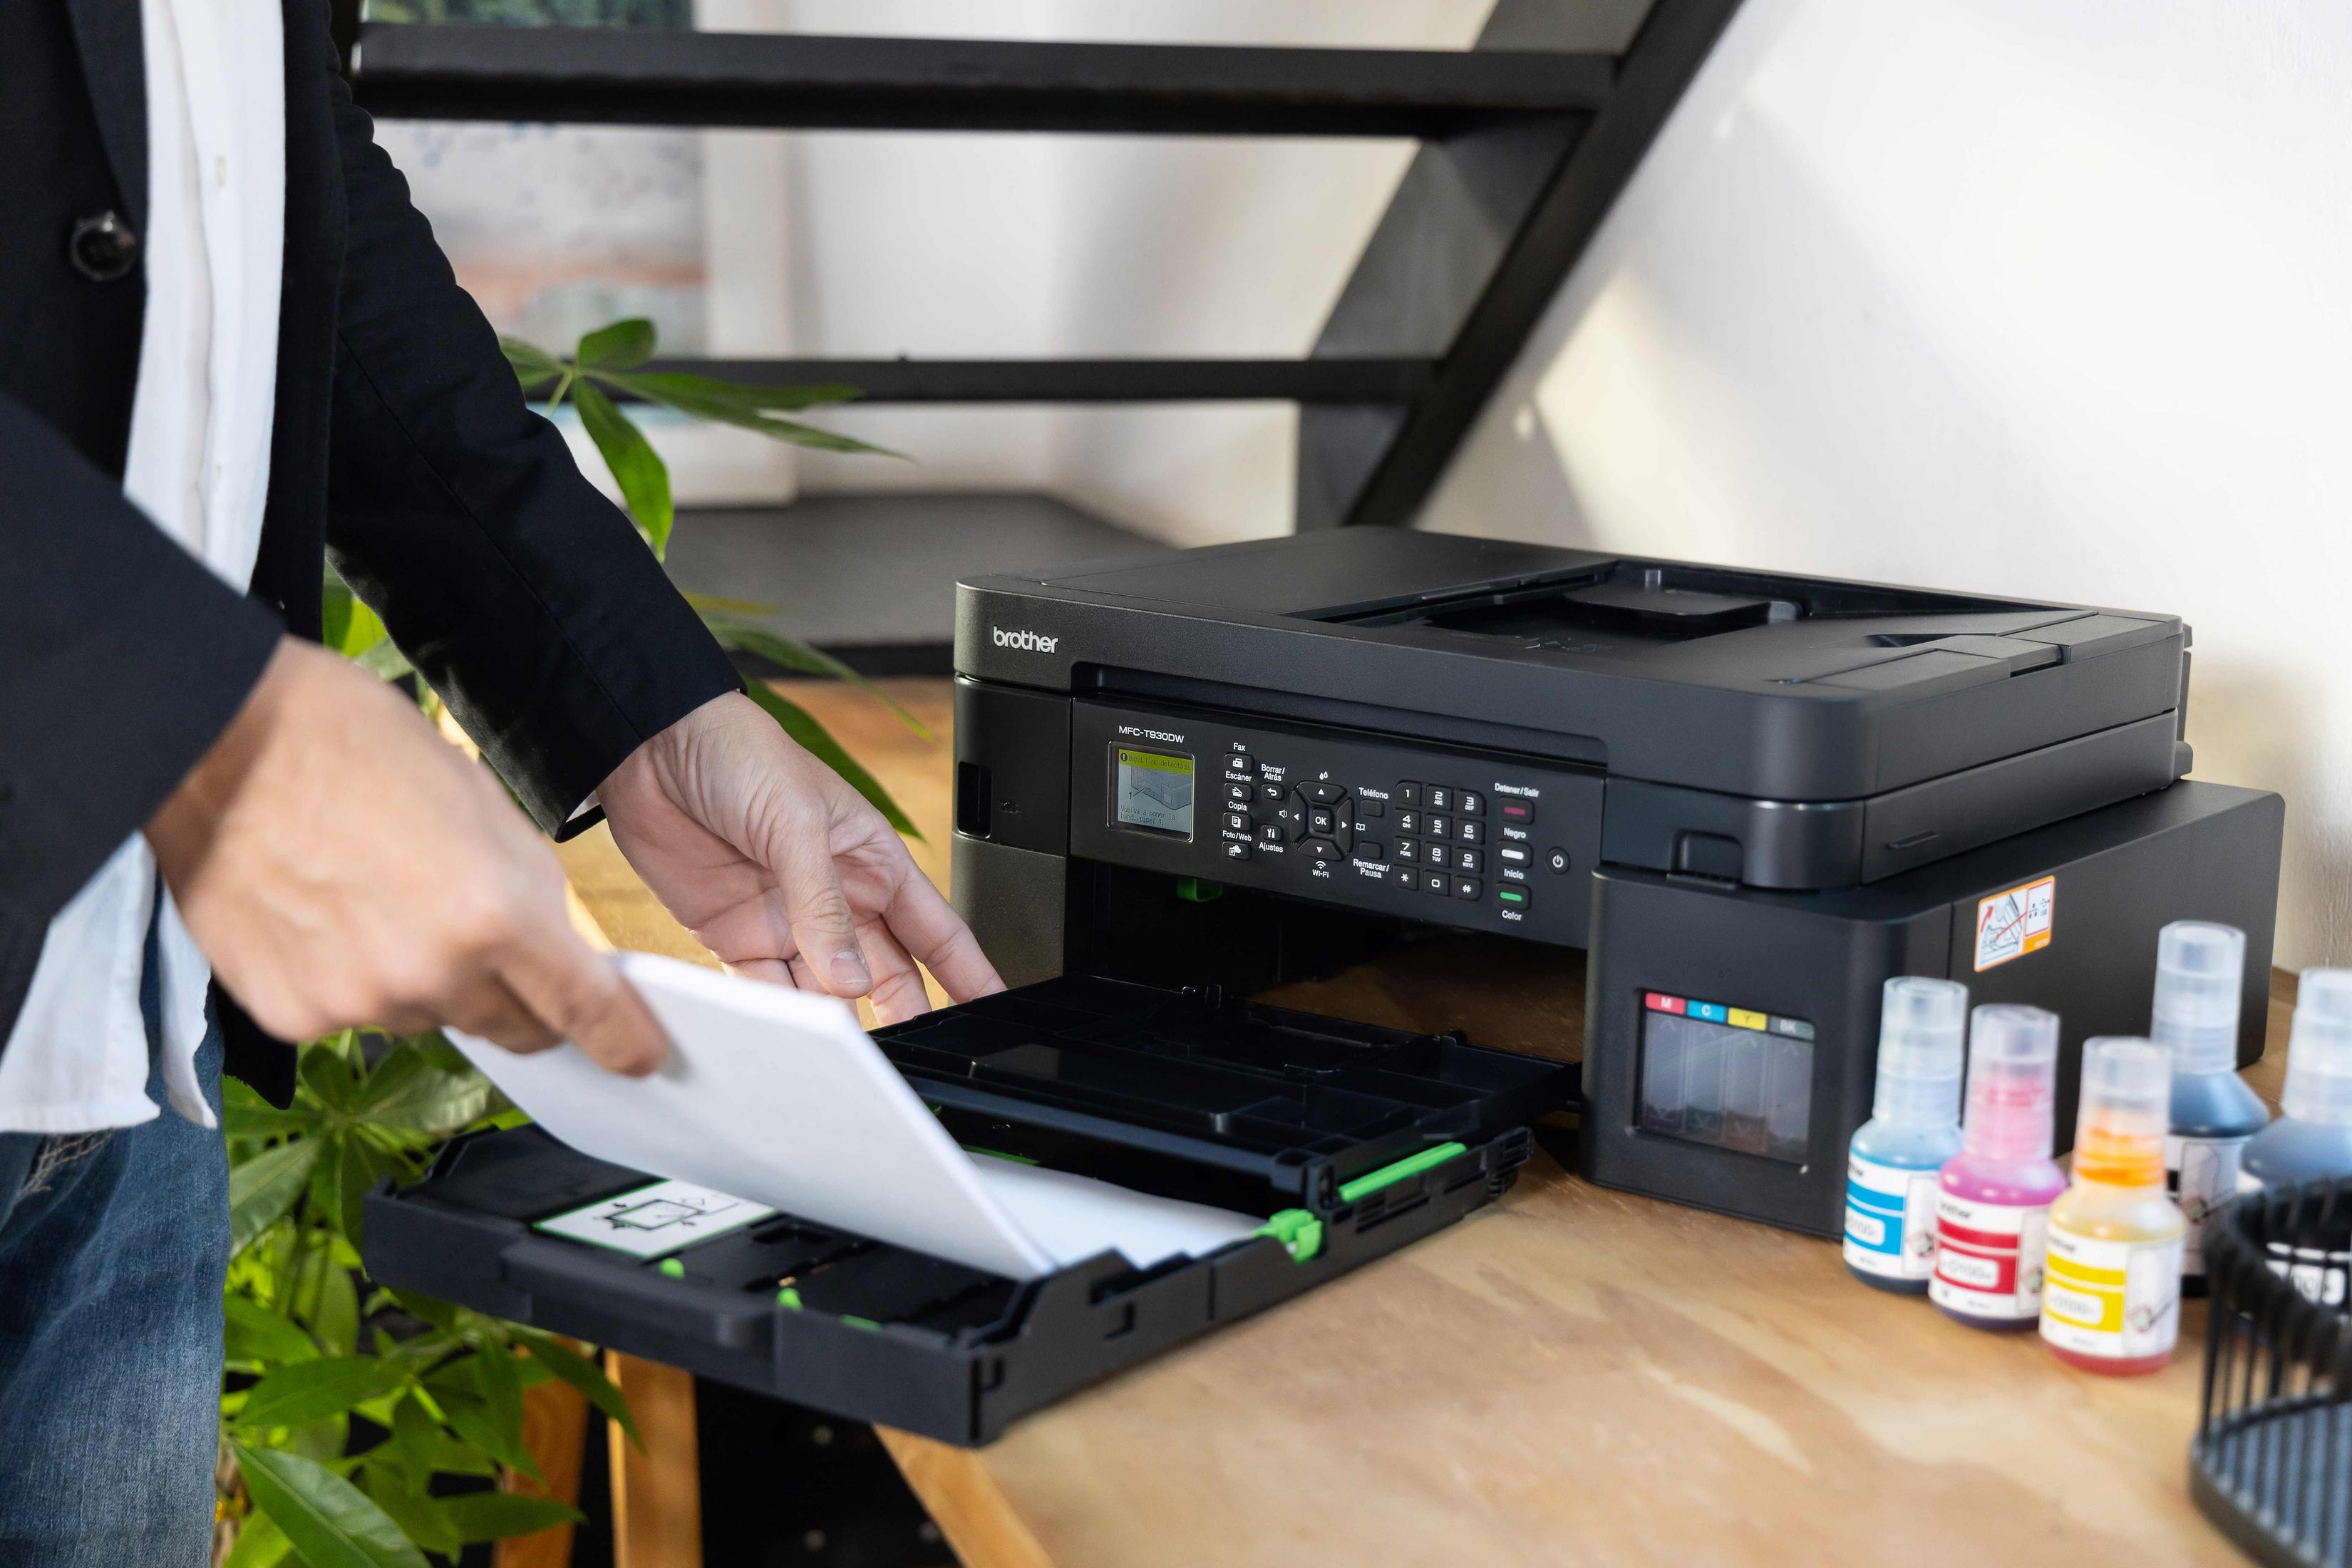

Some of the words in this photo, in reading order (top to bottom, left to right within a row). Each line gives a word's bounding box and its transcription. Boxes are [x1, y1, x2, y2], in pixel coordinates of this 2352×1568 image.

[993, 626, 1058, 654] brother
[1118, 725, 1185, 743] MFC-T930DW
[1233, 742, 1246, 751] Fax
[1161, 760, 1190, 770] detectada
[1261, 763, 1286, 775] Borrar/
[1225, 770, 1252, 782] Escáner
[1264, 772, 1282, 782] Atrás
[1358, 787, 1389, 800] Teléfono
[1405, 789, 1410, 798] 1
[1435, 791, 1443, 800] 2
[1494, 783, 1540, 798] Detener/Salir
[1466, 796, 1475, 805] 3
[1228, 801, 1247, 812] Copia
[1120, 805, 1140, 814] Vuelva
[1149, 811, 1166, 820] poner
[1140, 816, 1156, 826] papel
[1315, 816, 1327, 825] OK
[1402, 815, 1410, 823] 4
[1434, 820, 1442, 828] 5
[1465, 825, 1473, 834] 6
[1503, 827, 1527, 840] Negro
[1222, 830, 1252, 842] Foto/Web
[1259, 842, 1284, 853] Ajustes
[1402, 842, 1410, 851] 7
[1432, 847, 1441, 857] 8
[1464, 853, 1472, 862] 9
[1353, 858, 1390, 872] Remarcar/
[1312, 869, 1329, 879] Wi-Fi
[1360, 867, 1382, 879] Pausa
[1504, 868, 1525, 880] Inicio
[1502, 909, 1522, 922] Color
[1661, 996, 1672, 1009] M
[1701, 1004, 1711, 1017] C
[1779, 1018, 1797, 1033] BK
